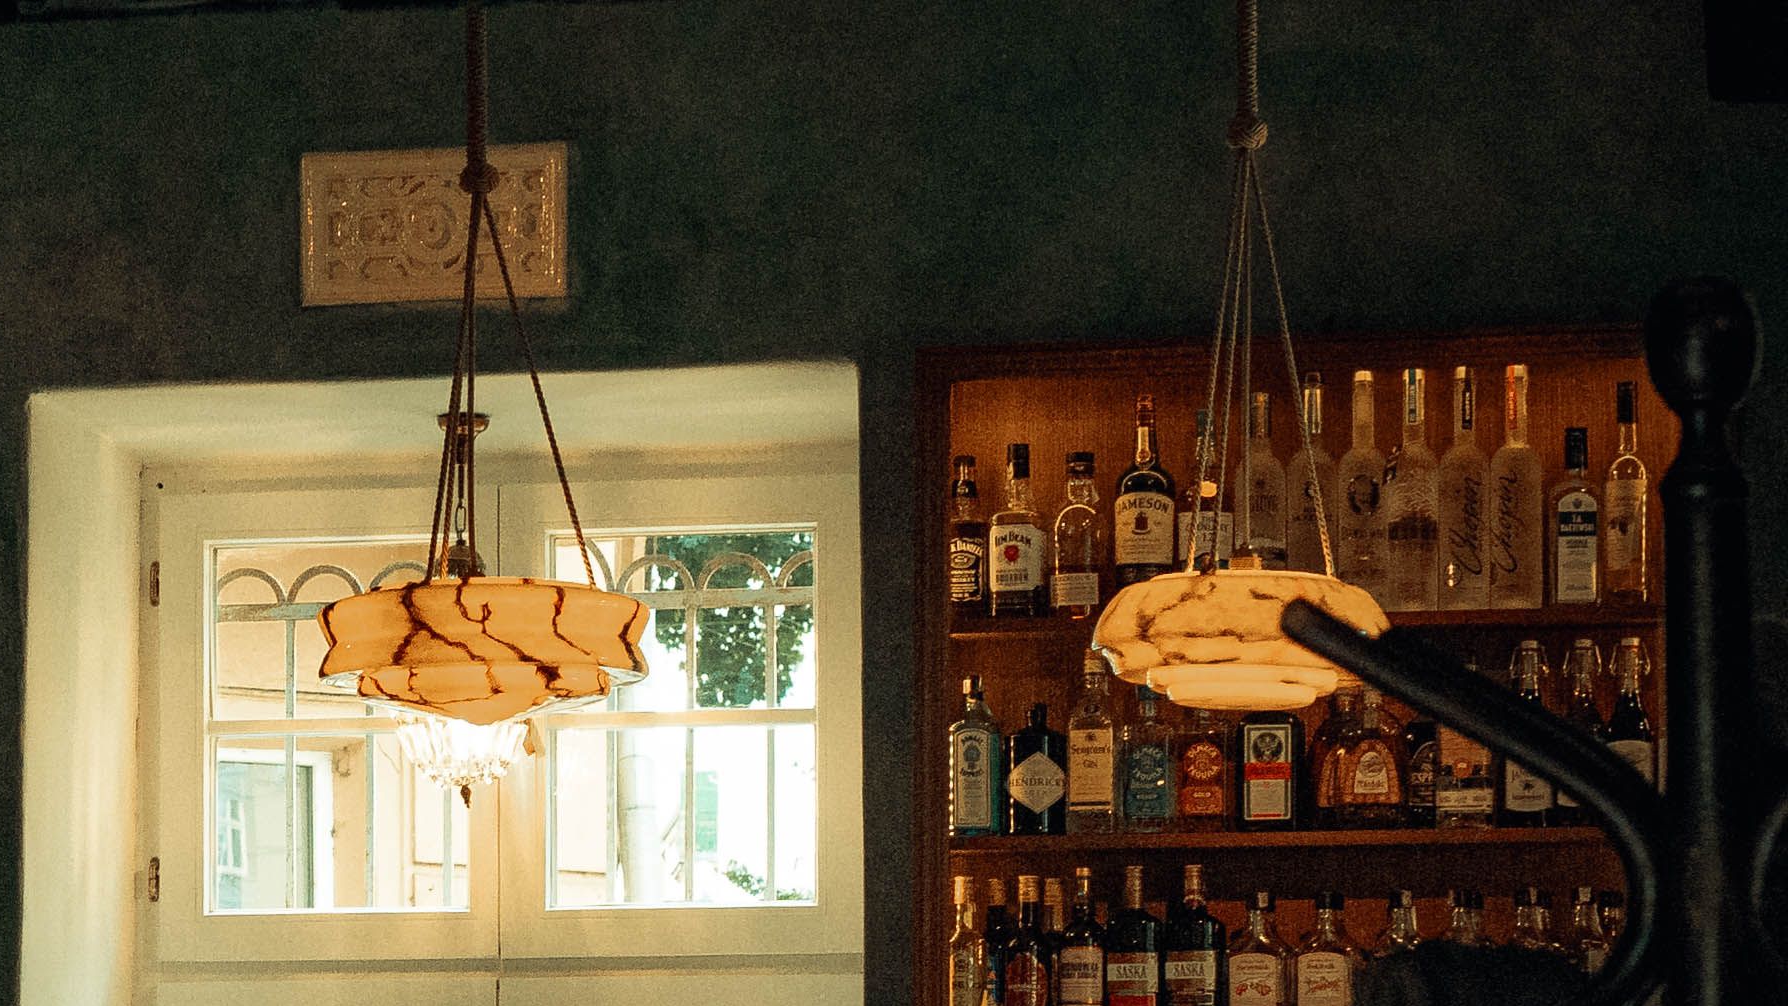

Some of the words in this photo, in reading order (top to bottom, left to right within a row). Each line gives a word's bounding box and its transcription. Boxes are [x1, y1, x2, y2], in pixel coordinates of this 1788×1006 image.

[1118, 498, 1170, 513] JAMESON
[995, 535, 1008, 548] JIM
[1009, 531, 1031, 546] BEAM
[1115, 965, 1148, 979] SASKA
[1172, 963, 1205, 977] SASKA
